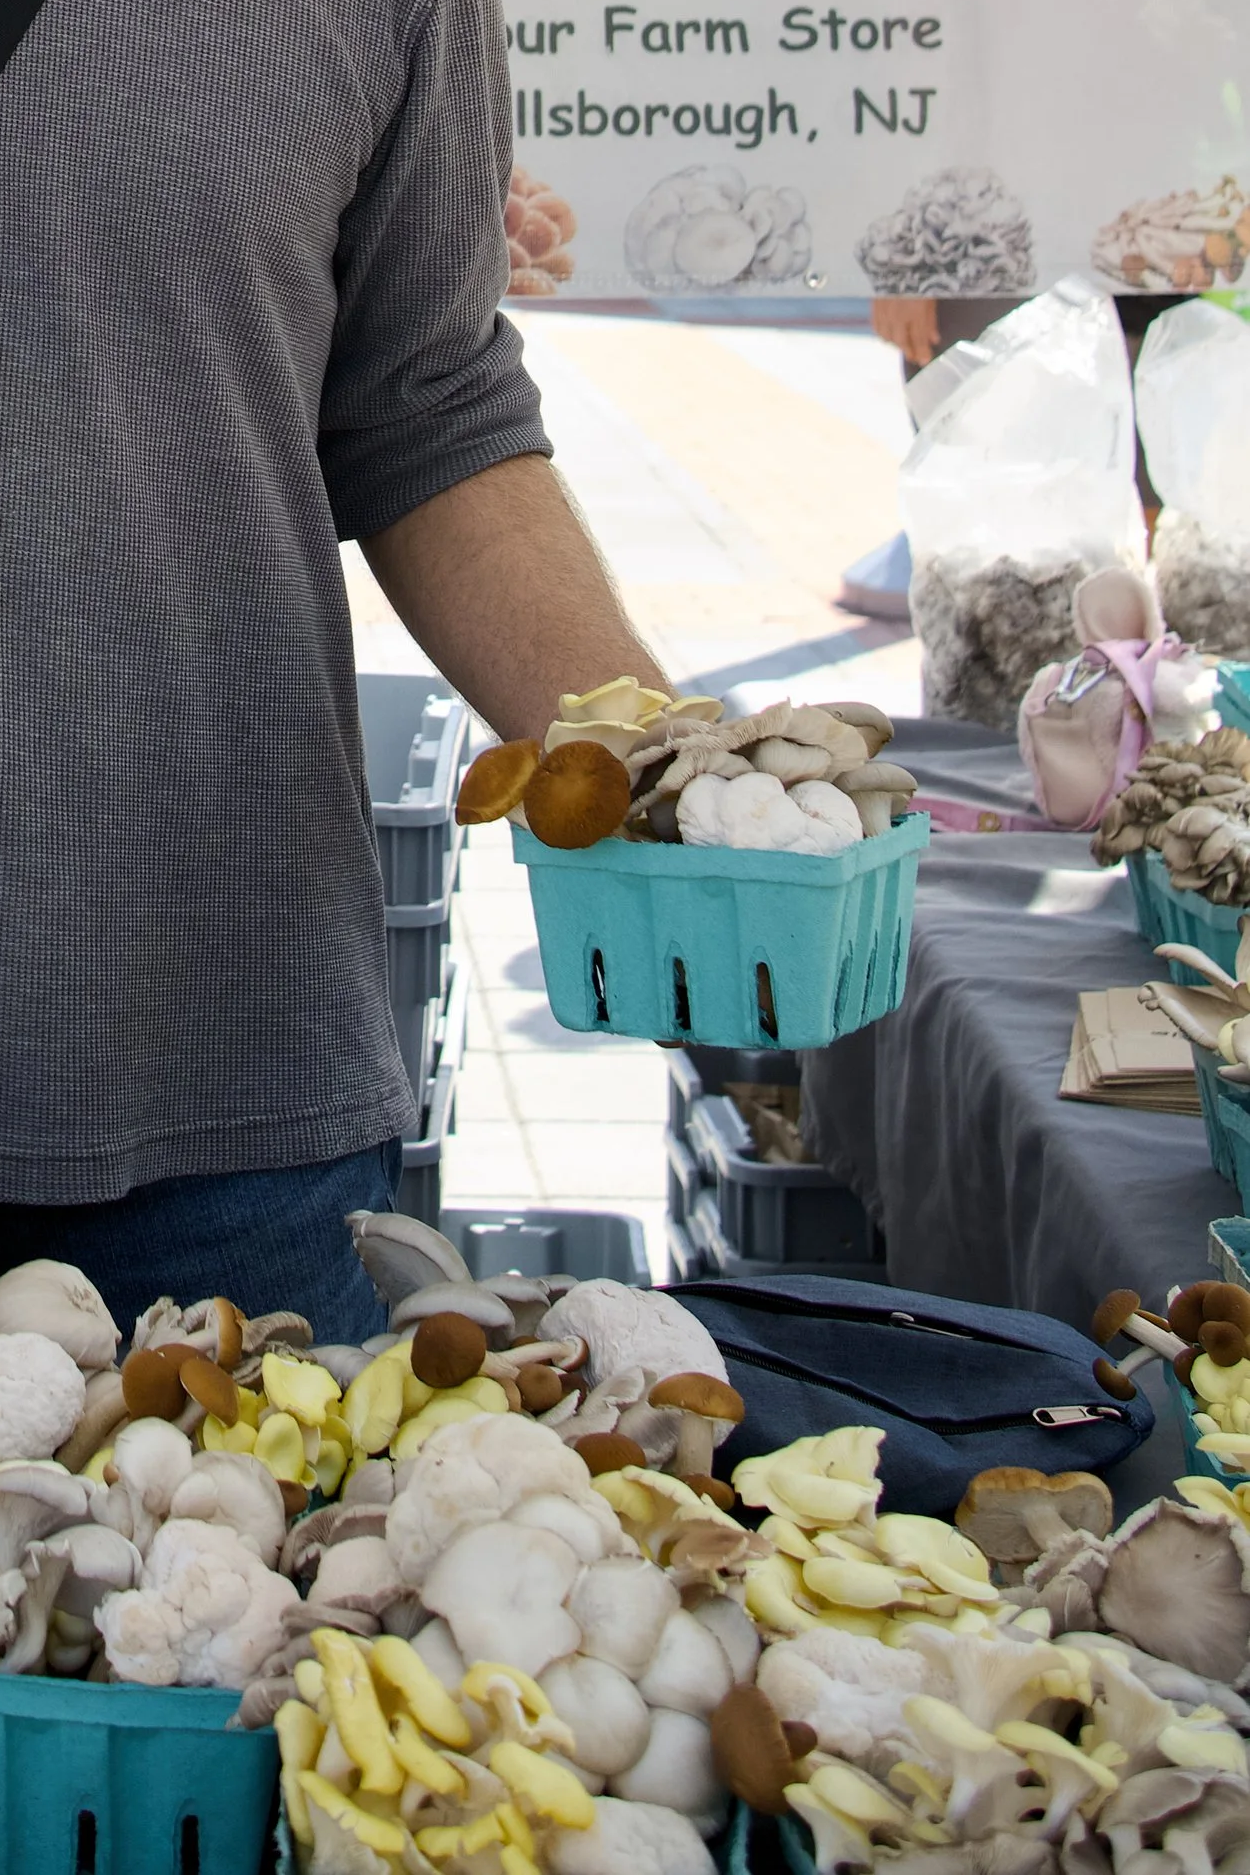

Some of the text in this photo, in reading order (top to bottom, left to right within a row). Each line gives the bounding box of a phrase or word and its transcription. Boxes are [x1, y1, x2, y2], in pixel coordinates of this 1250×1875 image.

[506, 4, 944, 55] ur Farm Store
[516, 86, 938, 150] llsborough, NJ
